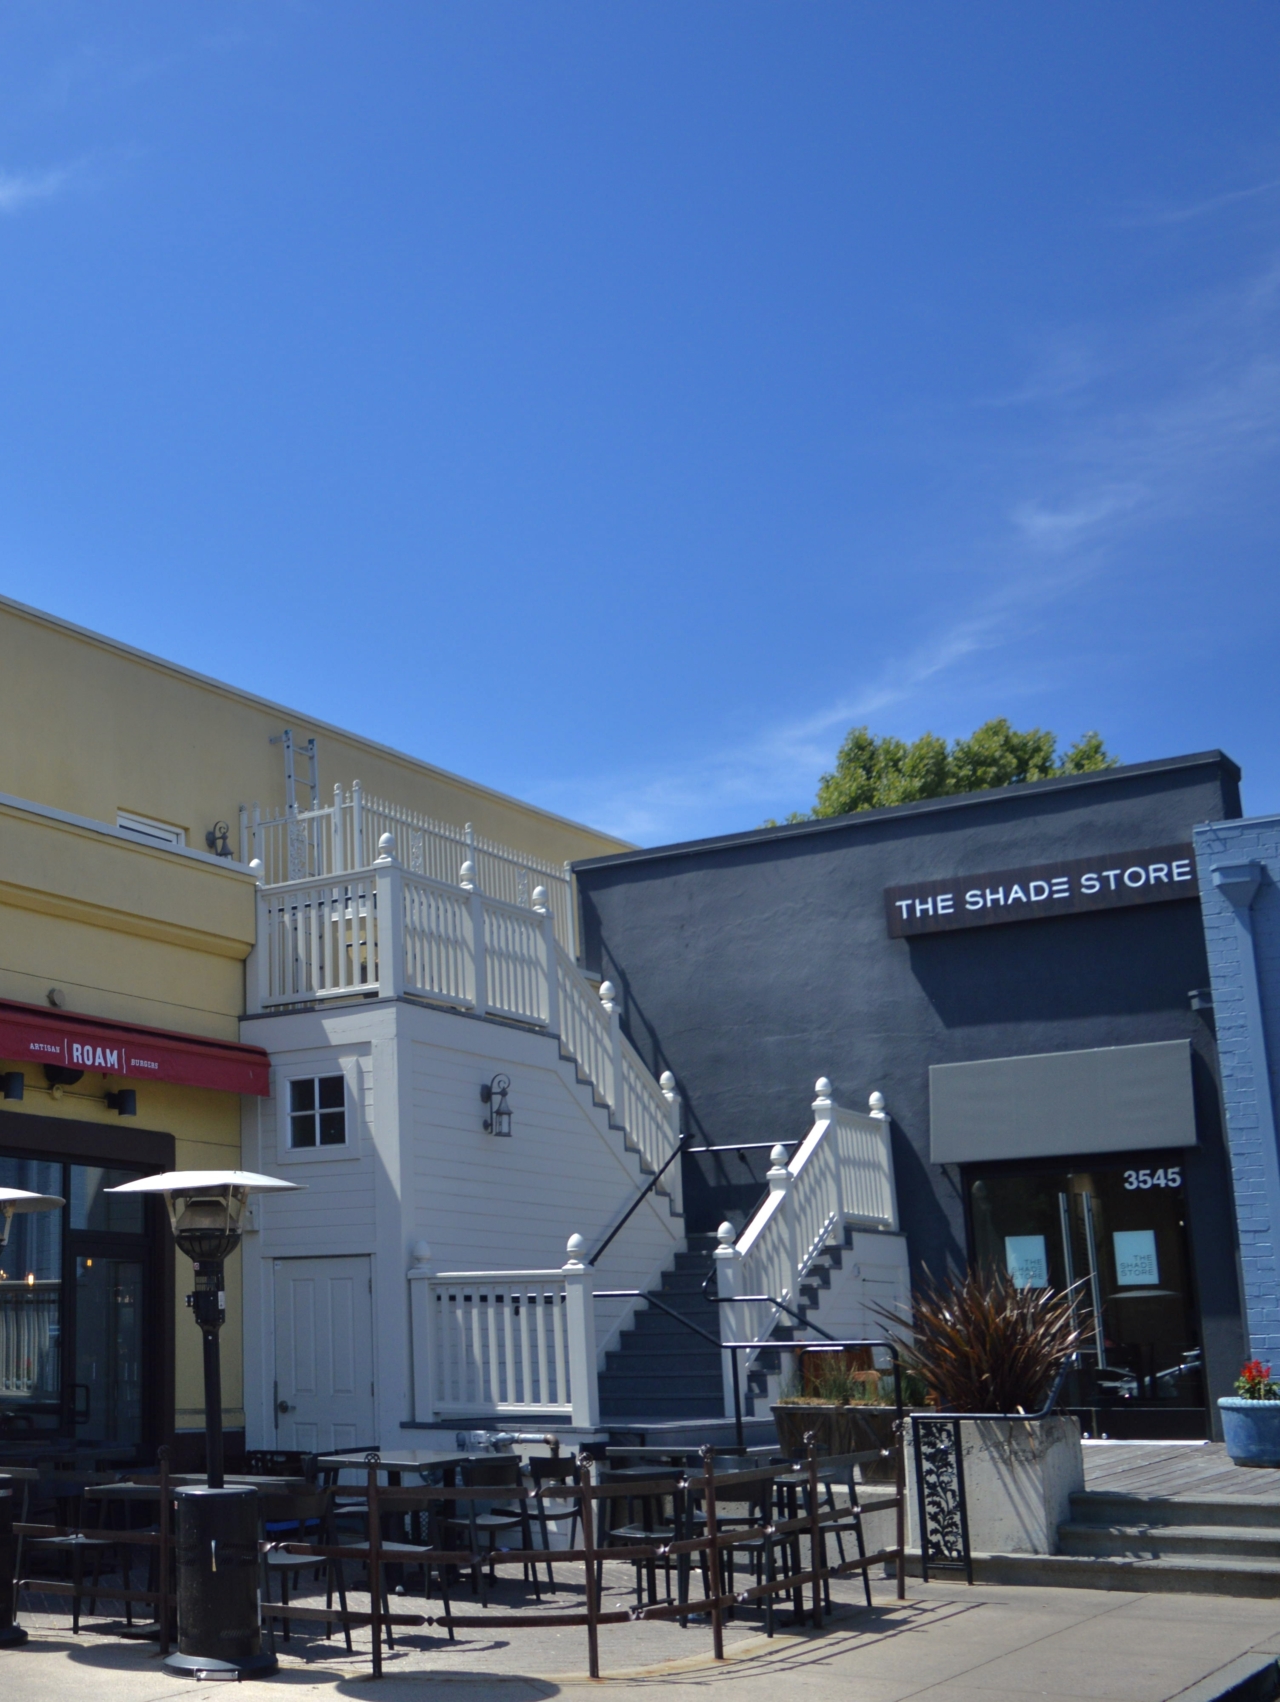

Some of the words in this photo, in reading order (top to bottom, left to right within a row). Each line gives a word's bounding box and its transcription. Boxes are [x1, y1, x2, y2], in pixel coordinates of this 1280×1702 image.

[895, 894, 954, 920] THE
[964, 876, 1070, 911] SHADE
[1080, 860, 1192, 894] STORE
[29, 1042, 61, 1053] ARTISAN
[72, 1043, 119, 1069] ROAM
[130, 1058, 159, 1070] BURGERS
[1123, 1167, 1181, 1190] 3545
